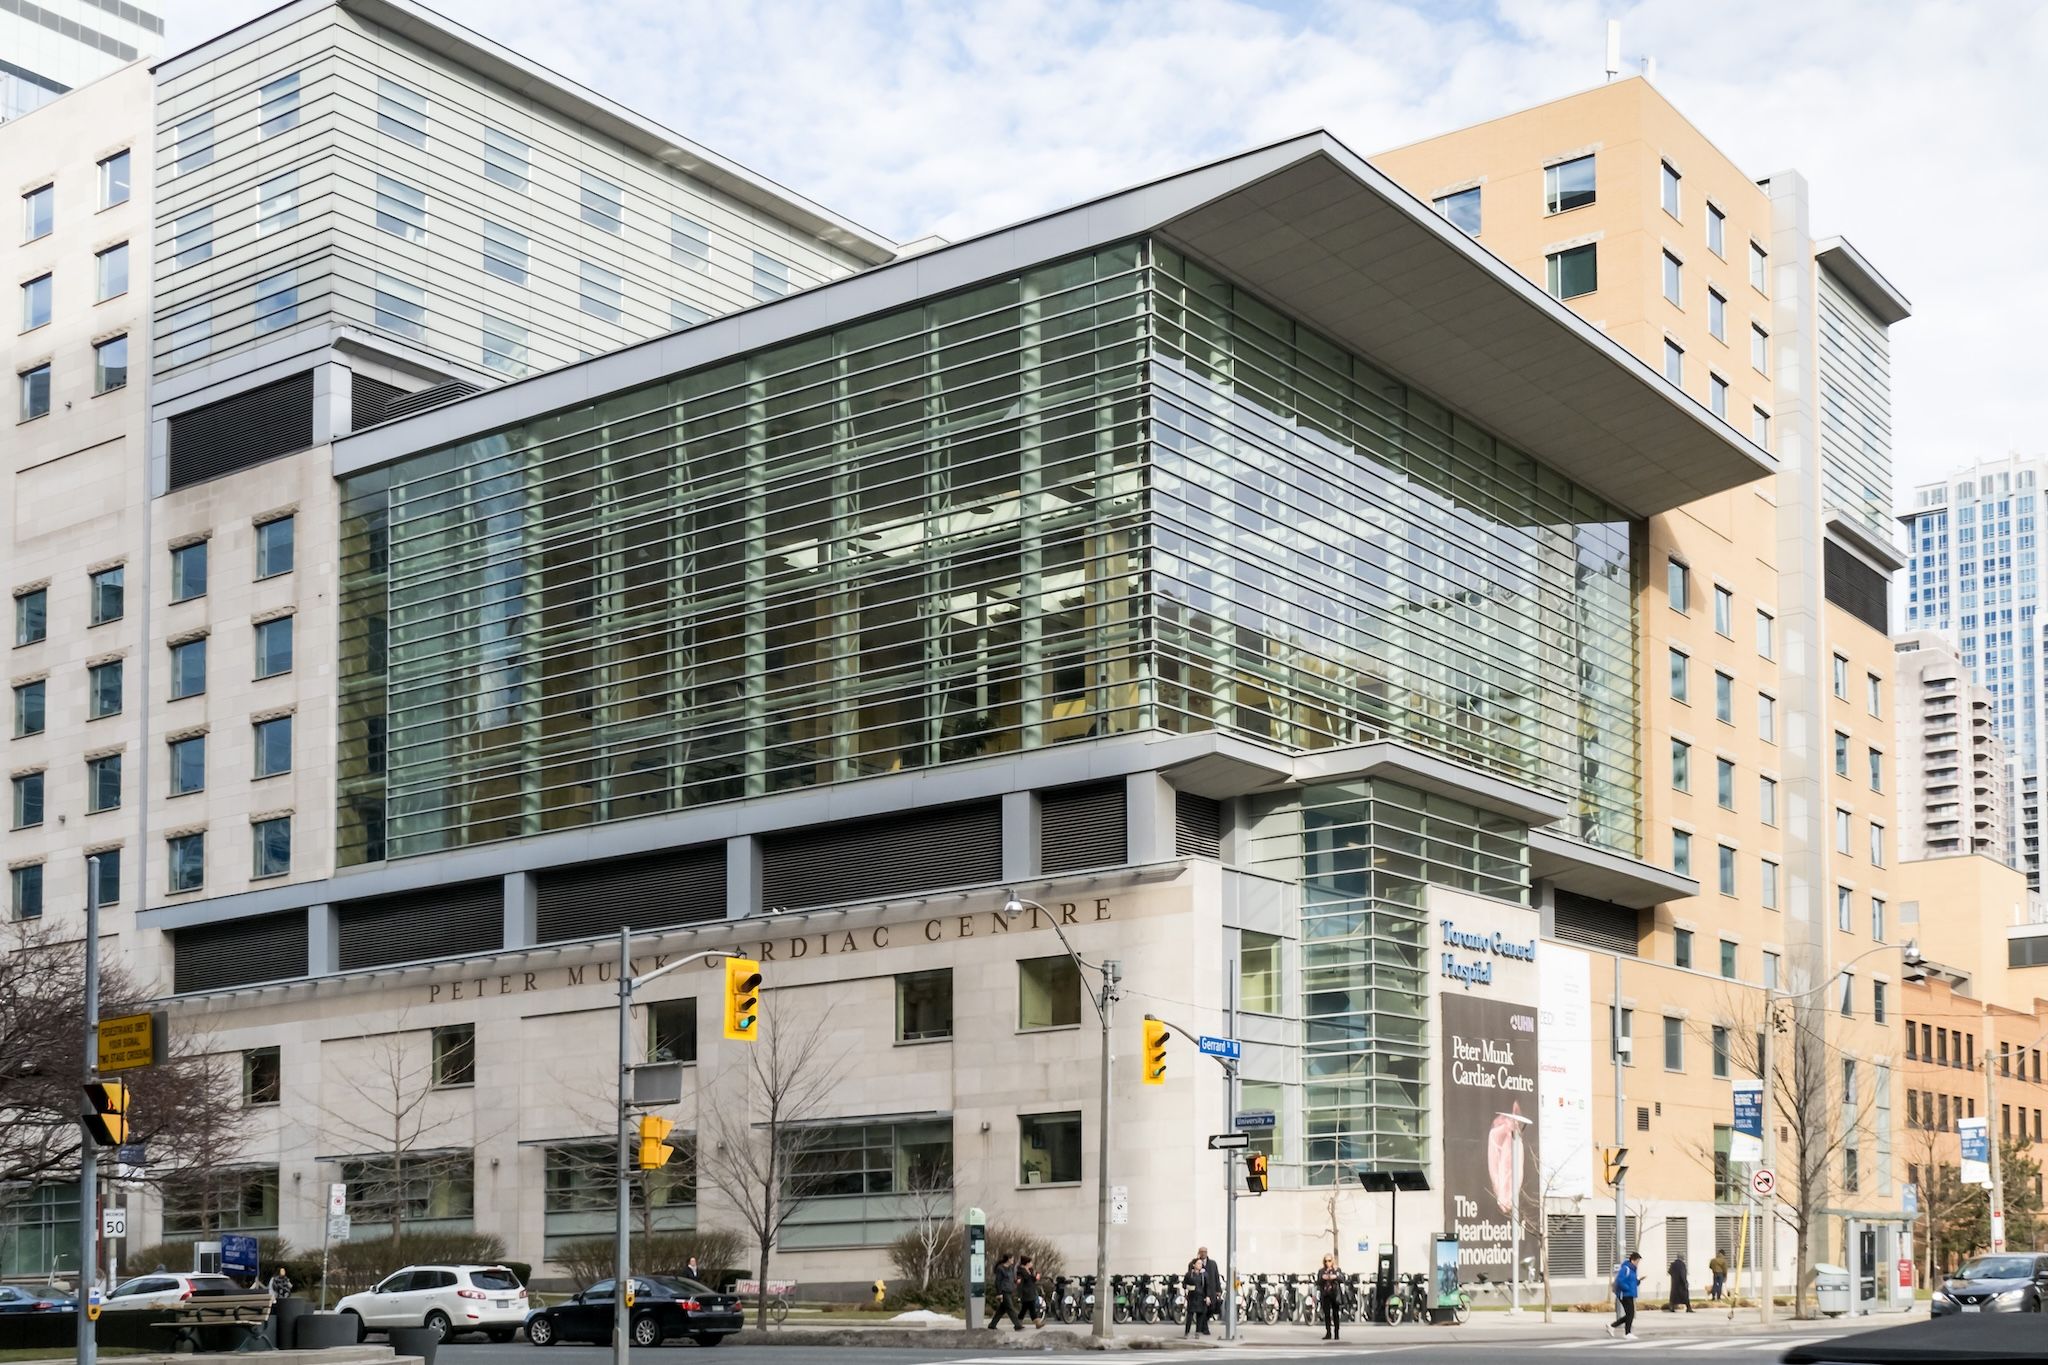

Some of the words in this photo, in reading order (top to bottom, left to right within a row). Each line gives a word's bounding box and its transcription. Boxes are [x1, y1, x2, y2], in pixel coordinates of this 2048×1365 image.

[430, 972, 538, 1003] PETER
[704, 926, 889, 968] CRDIAC
[925, 898, 1111, 941] CENTRE
[1440, 919, 1490, 953] Toronto
[1490, 931, 1535, 962] General
[1441, 952, 1491, 990] Hospital
[1517, 1015, 1534, 1032] UHN
[1201, 1037, 1226, 1053] Gerrard
[1232, 1043, 1239, 1054] W
[1453, 1035, 1481, 1061] Peter
[1482, 1039, 1514, 1065] Munk
[1452, 1061, 1496, 1088] Cardiac
[1498, 1066, 1534, 1092] Centre
[1236, 1117, 1265, 1126] University
[1454, 1195, 1478, 1217] The
[106, 1220, 124, 1234] 50
[1454, 1219, 1512, 1241] heartbeat
